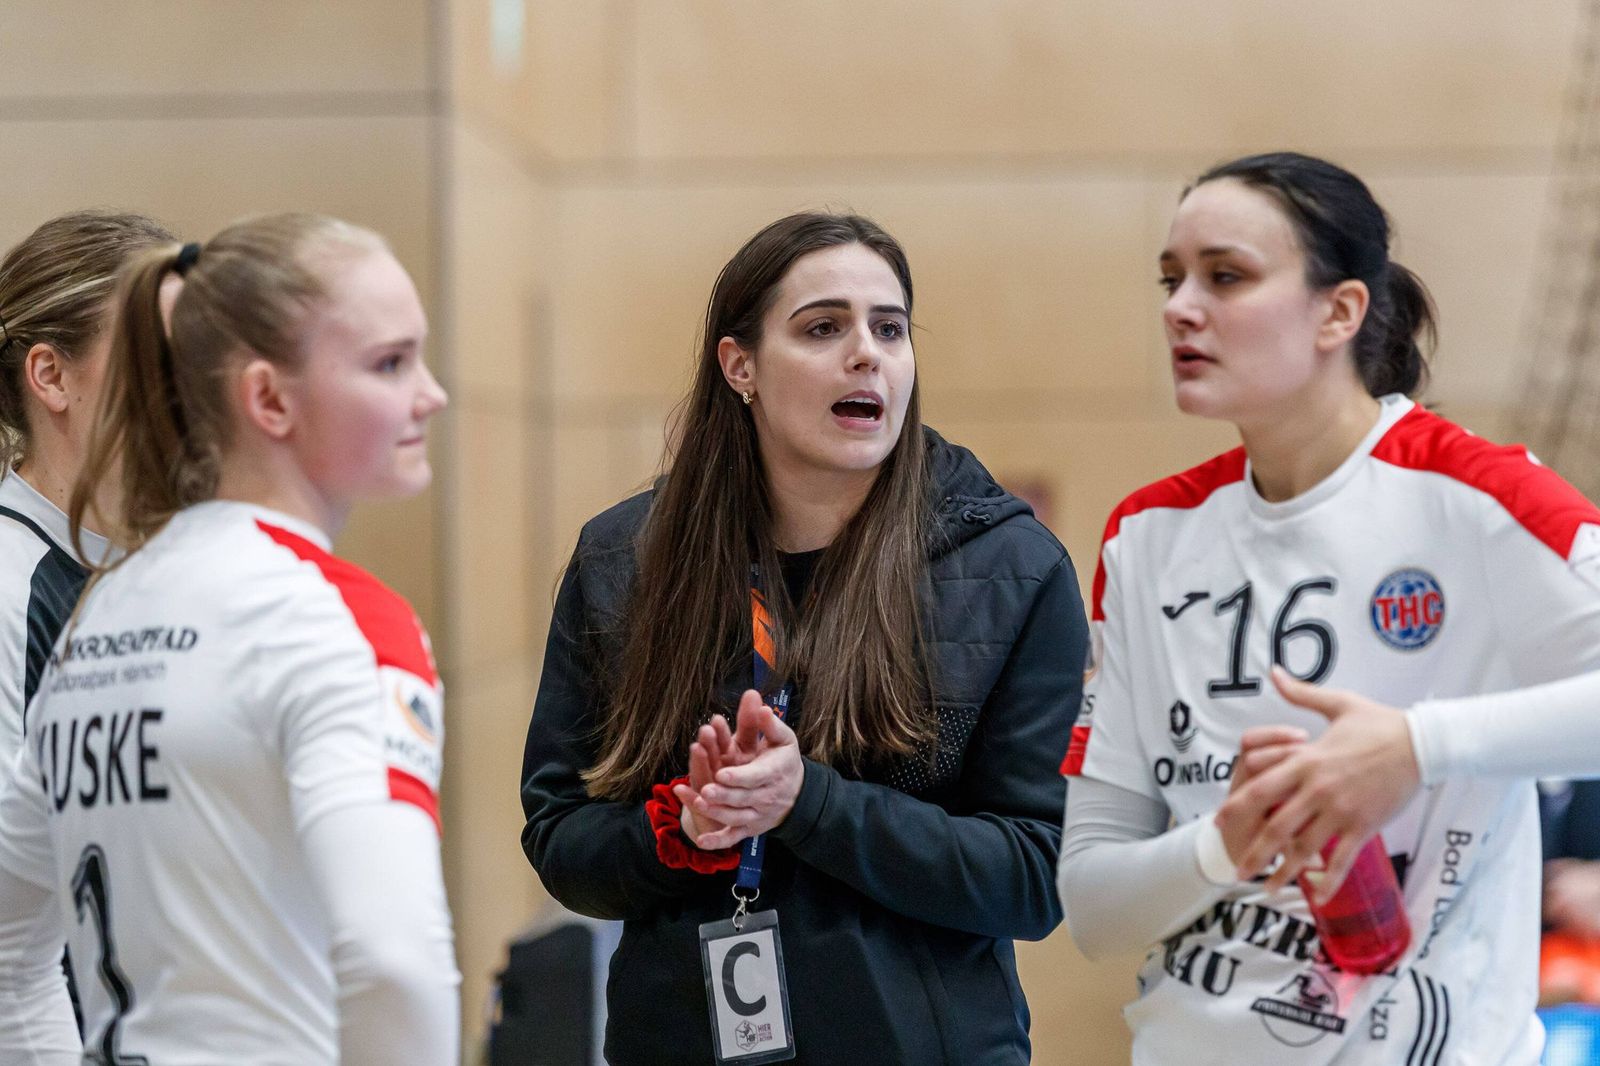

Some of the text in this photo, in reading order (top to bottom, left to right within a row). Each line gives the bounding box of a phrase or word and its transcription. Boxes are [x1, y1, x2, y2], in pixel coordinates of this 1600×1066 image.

[1207, 577, 1337, 698] 16
[1375, 591, 1443, 632] THC
[1440, 828, 1473, 886] Bad
[721, 940, 767, 1017] C
